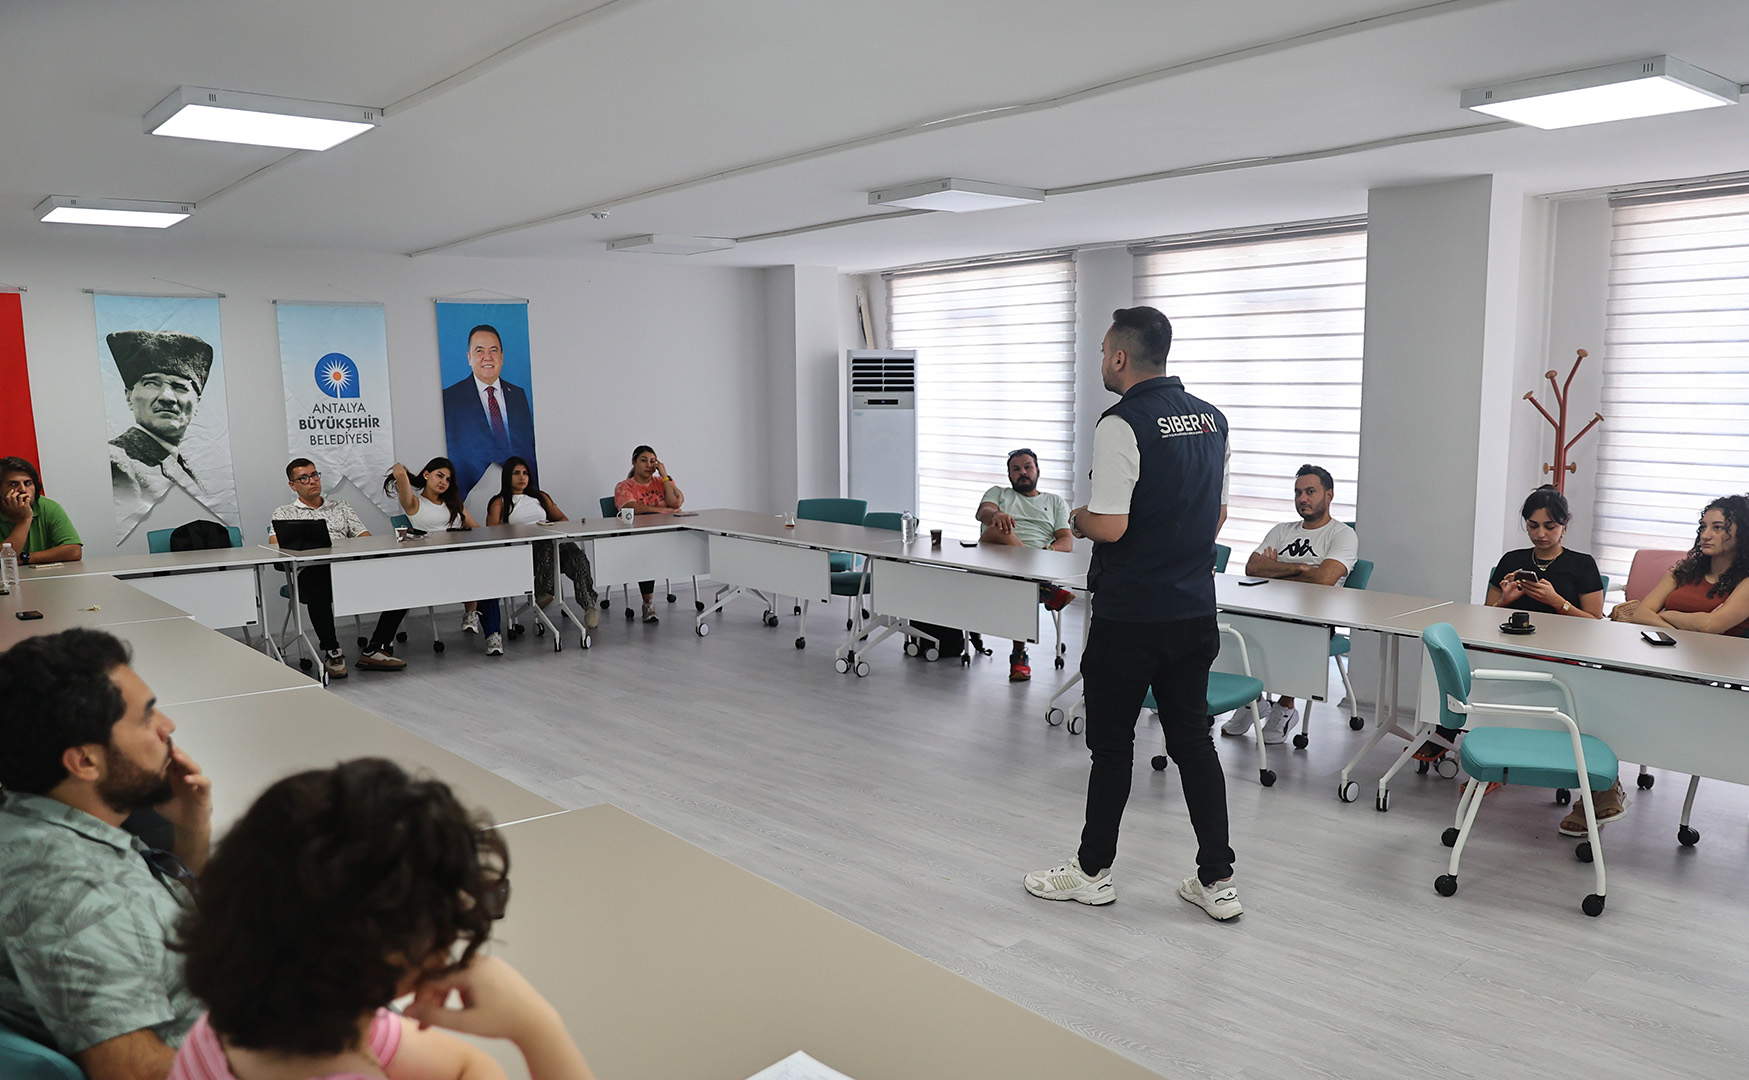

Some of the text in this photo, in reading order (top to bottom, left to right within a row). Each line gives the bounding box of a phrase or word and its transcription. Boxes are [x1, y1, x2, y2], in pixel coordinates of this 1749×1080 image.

[312, 402, 366, 414] ANTALYA
[298, 414, 380, 431] BÜYÜKŞEHİR
[310, 430, 373, 446] BELEDİYESİ
